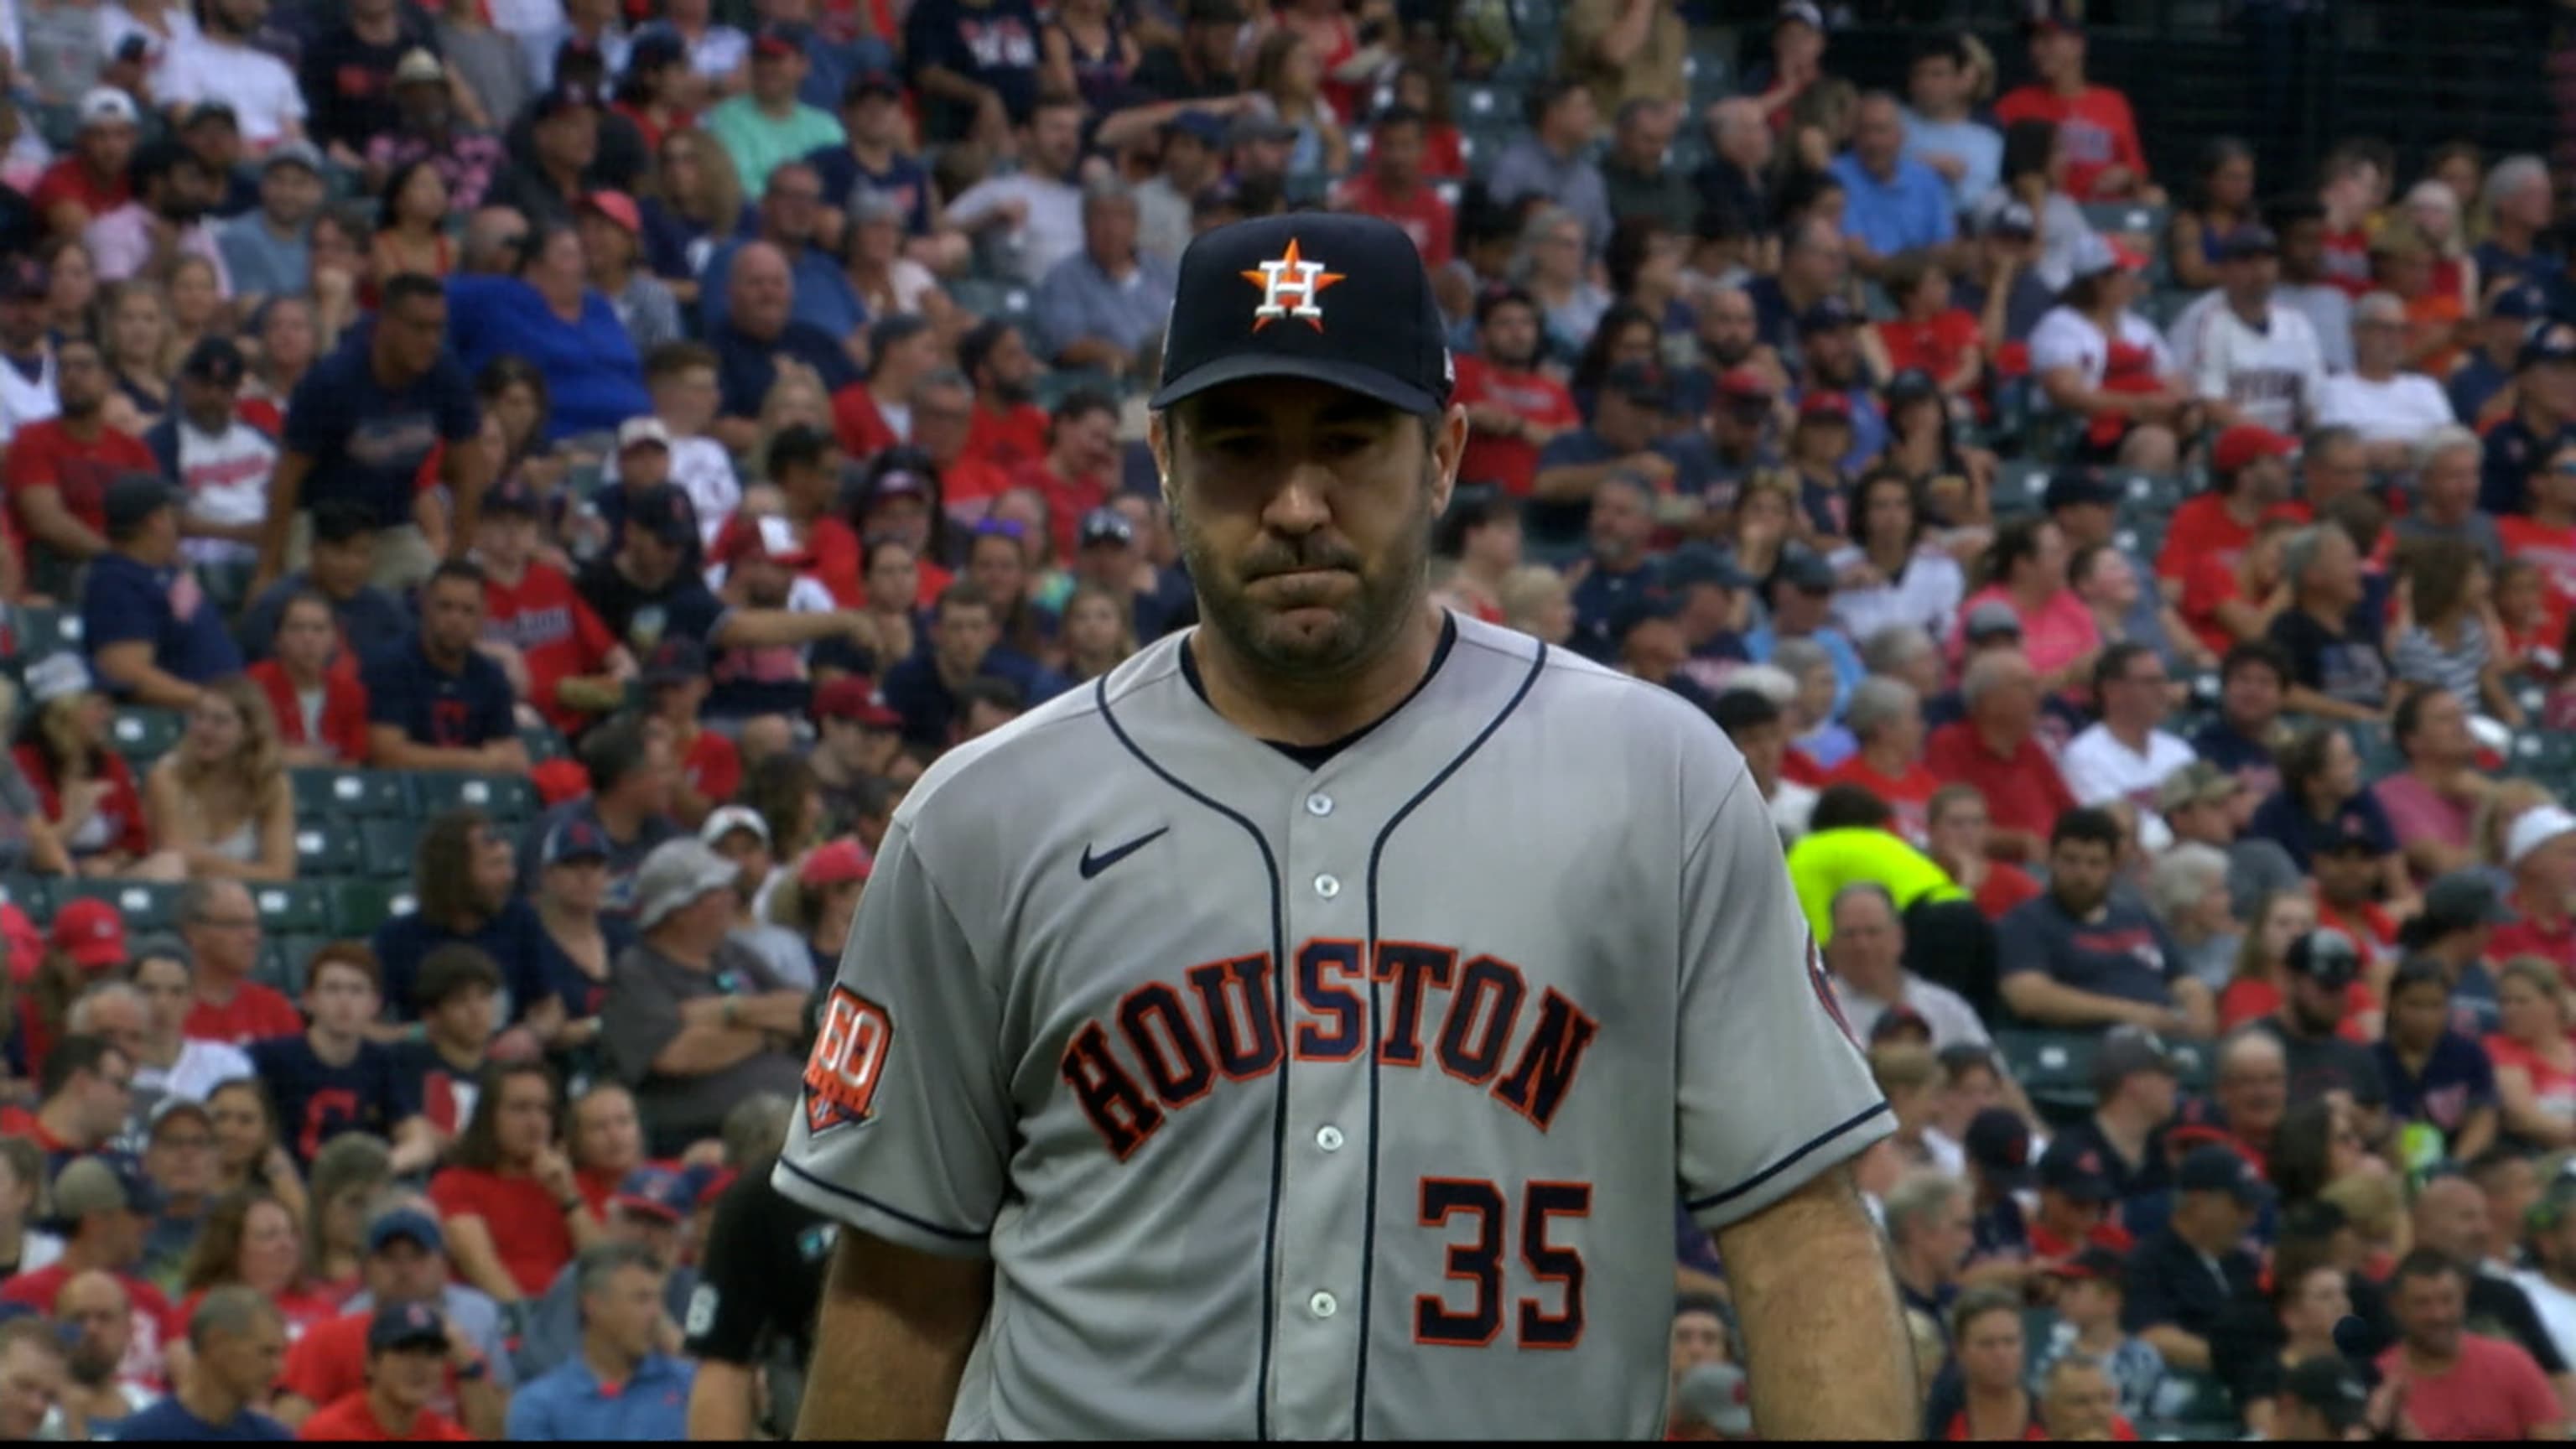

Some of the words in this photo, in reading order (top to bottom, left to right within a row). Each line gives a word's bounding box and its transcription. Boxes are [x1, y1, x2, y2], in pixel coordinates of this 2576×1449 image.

[1254, 261, 1325, 317] H
[818, 996, 883, 1088] 60
[1062, 937, 1601, 1163] HOUSTON
[1413, 1176, 1593, 1350] 35
